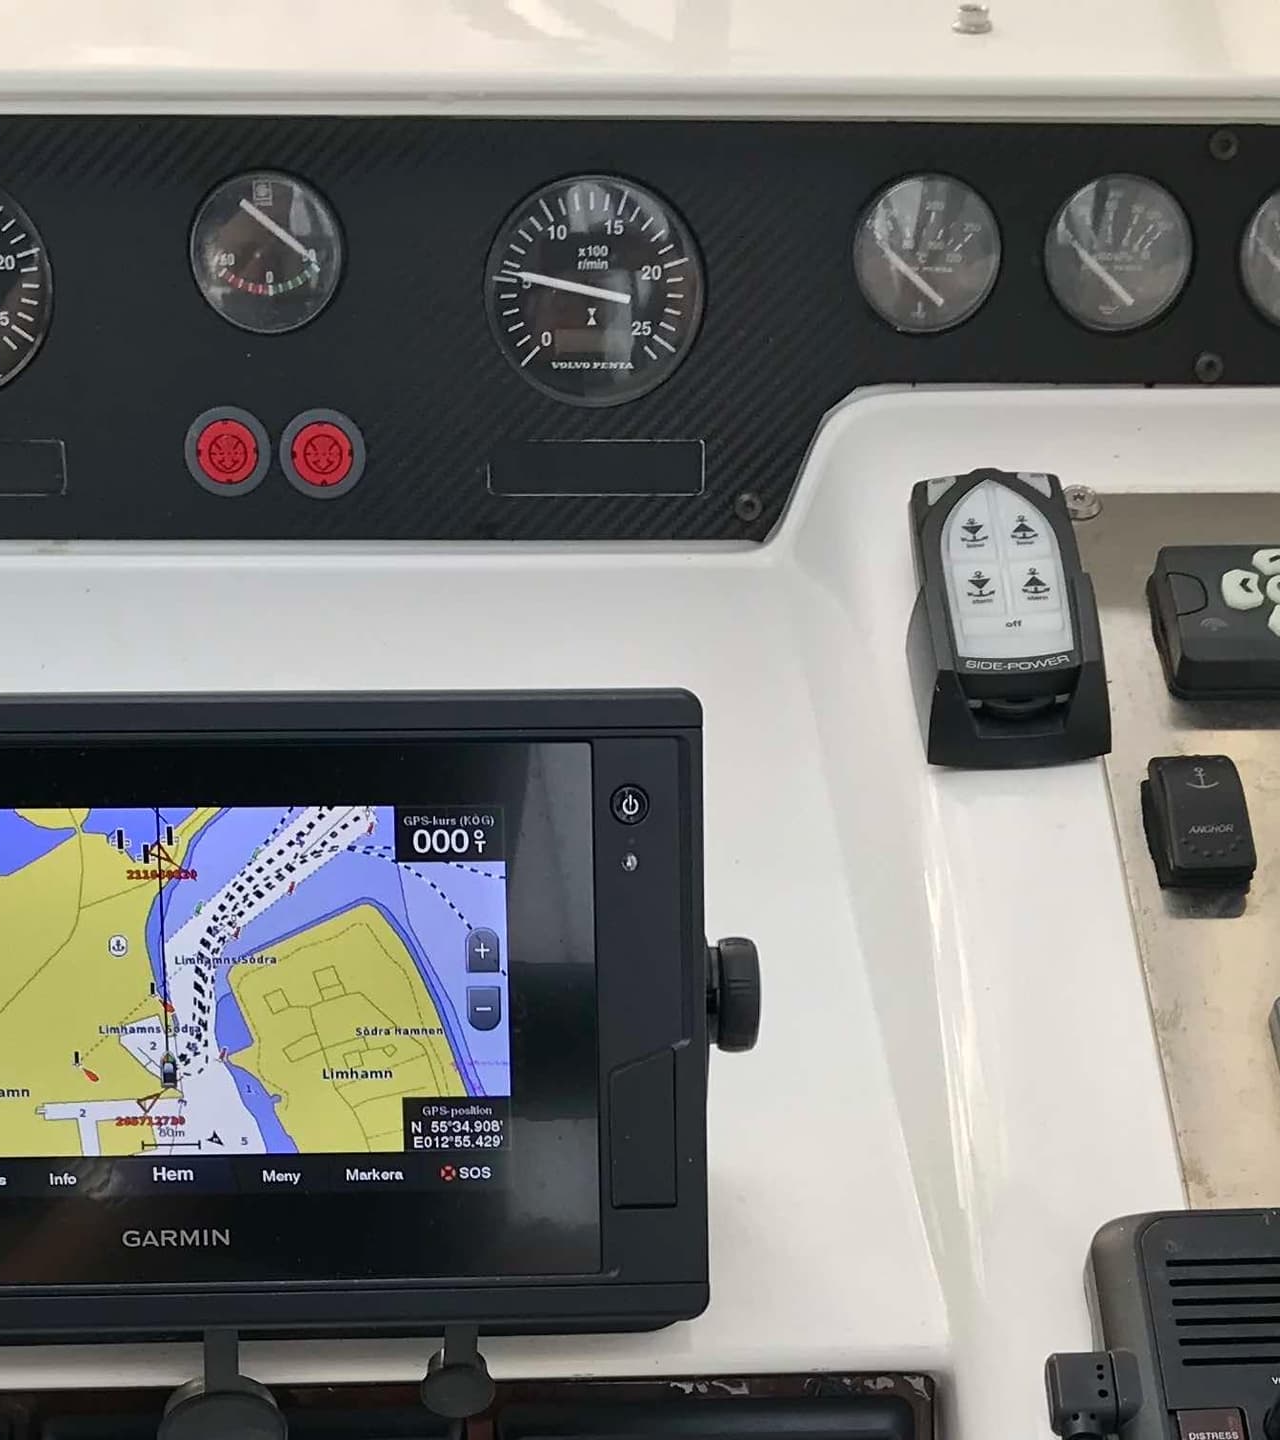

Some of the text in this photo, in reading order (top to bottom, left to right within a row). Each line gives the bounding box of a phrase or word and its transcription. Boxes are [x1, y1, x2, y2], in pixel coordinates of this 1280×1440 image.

[547, 224, 567, 240] 10
[604, 219, 624, 235] 15
[578, 245, 608, 257] x100
[577, 260, 609, 270] r/min
[266, 271, 274, 283] 0
[641, 265, 662, 280] 20
[631, 321, 652, 336] 25
[541, 331, 552, 346] 0
[551, 361, 634, 369] VOLVO PENTA
[1005, 620, 1022, 628] off
[965, 655, 1071, 671] SIDE-POWER
[403, 816, 457, 828] GPS-kurs
[1188, 823, 1234, 834] ANCHOR
[412, 829, 469, 854] 000
[98, 1024, 161, 1034] Limhamns
[394, 1027, 444, 1036] Hamnen
[150, 1042, 157, 1050] 2
[322, 1067, 394, 1080] Limhamn
[79, 1108, 87, 1118] 2
[422, 1106, 493, 1117] GPS-position
[411, 1121, 422, 1133] N
[241, 1137, 248, 1146] 5
[152, 1166, 194, 1182] Hem
[262, 1169, 301, 1185] Meny
[346, 1168, 405, 1181] Markera
[458, 1166, 492, 1180] SOS
[49, 1173, 78, 1186] Info
[122, 1229, 231, 1248] GARMIN
[1189, 1431, 1239, 1440] DISTRESS
